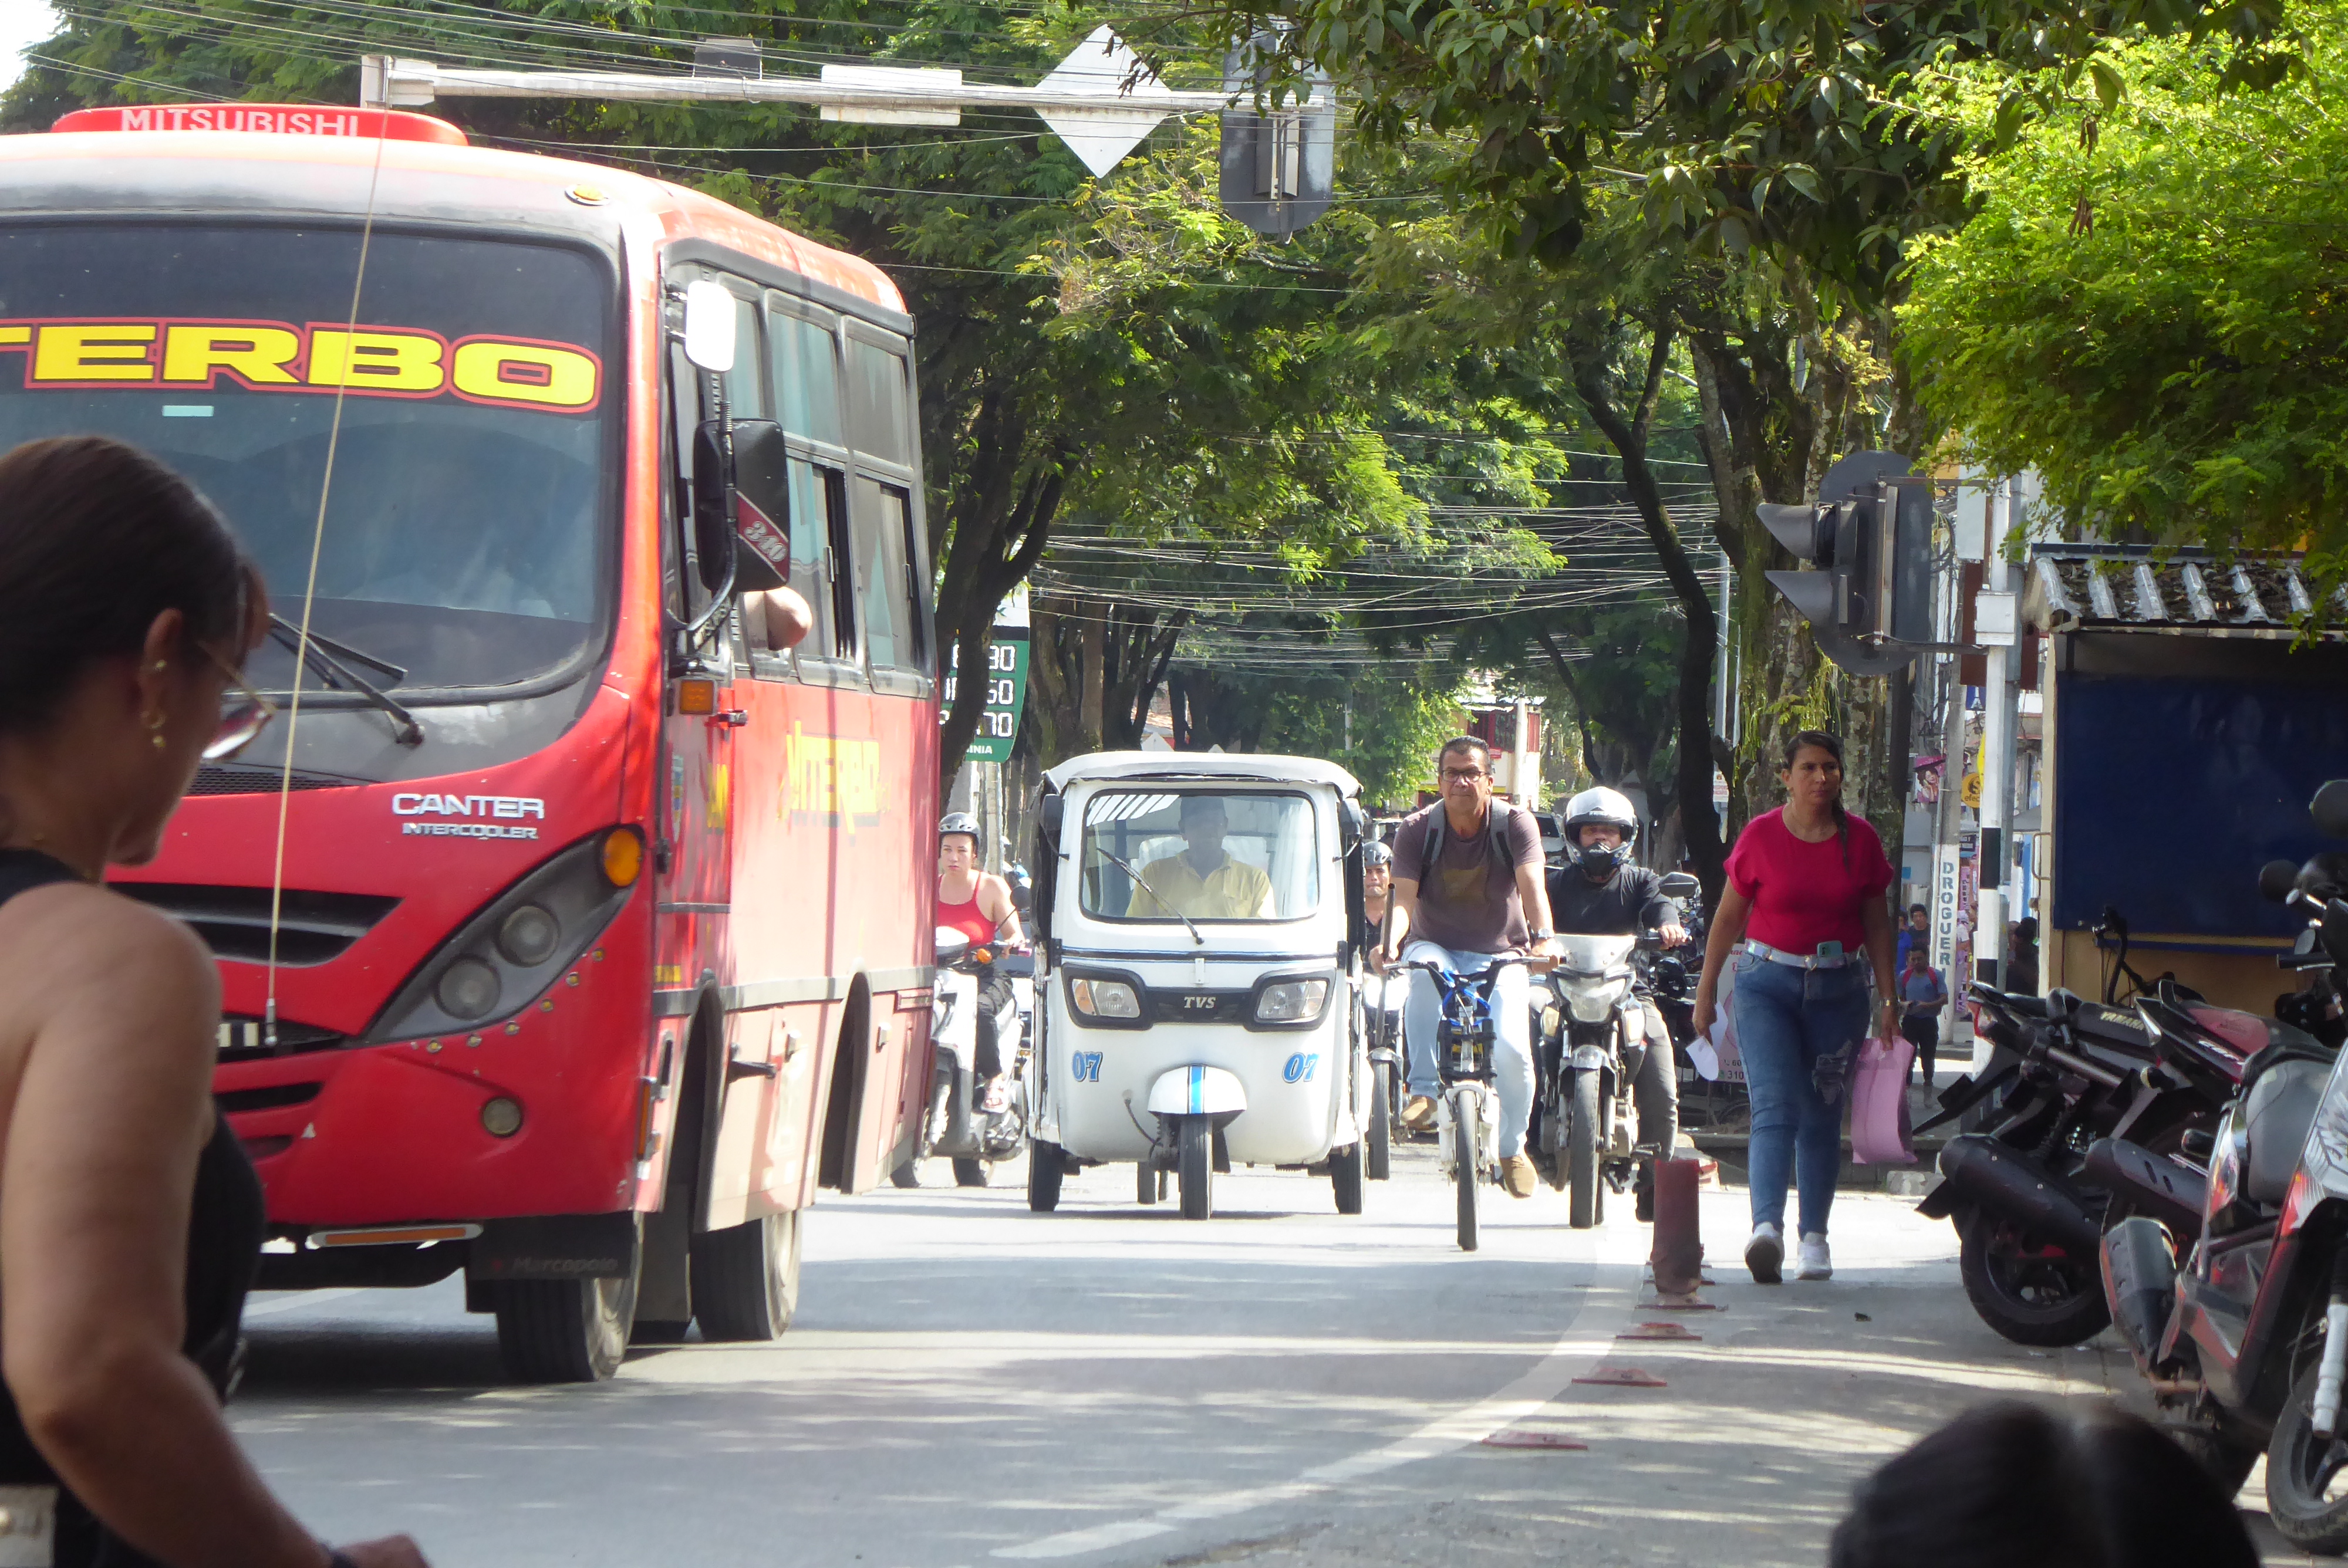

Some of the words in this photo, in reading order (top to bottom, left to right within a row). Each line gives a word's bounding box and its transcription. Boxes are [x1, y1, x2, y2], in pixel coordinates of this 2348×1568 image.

[121, 108, 359, 137] MITSUBISHI
[966, 745, 993, 754] INIA
[392, 793, 545, 819] CANTER
[402, 822, 539, 840] INTERCOOLER
[1183, 996, 1216, 1009] TVS
[1071, 1050, 1103, 1082] 07
[1282, 1051, 1320, 1084] 07
